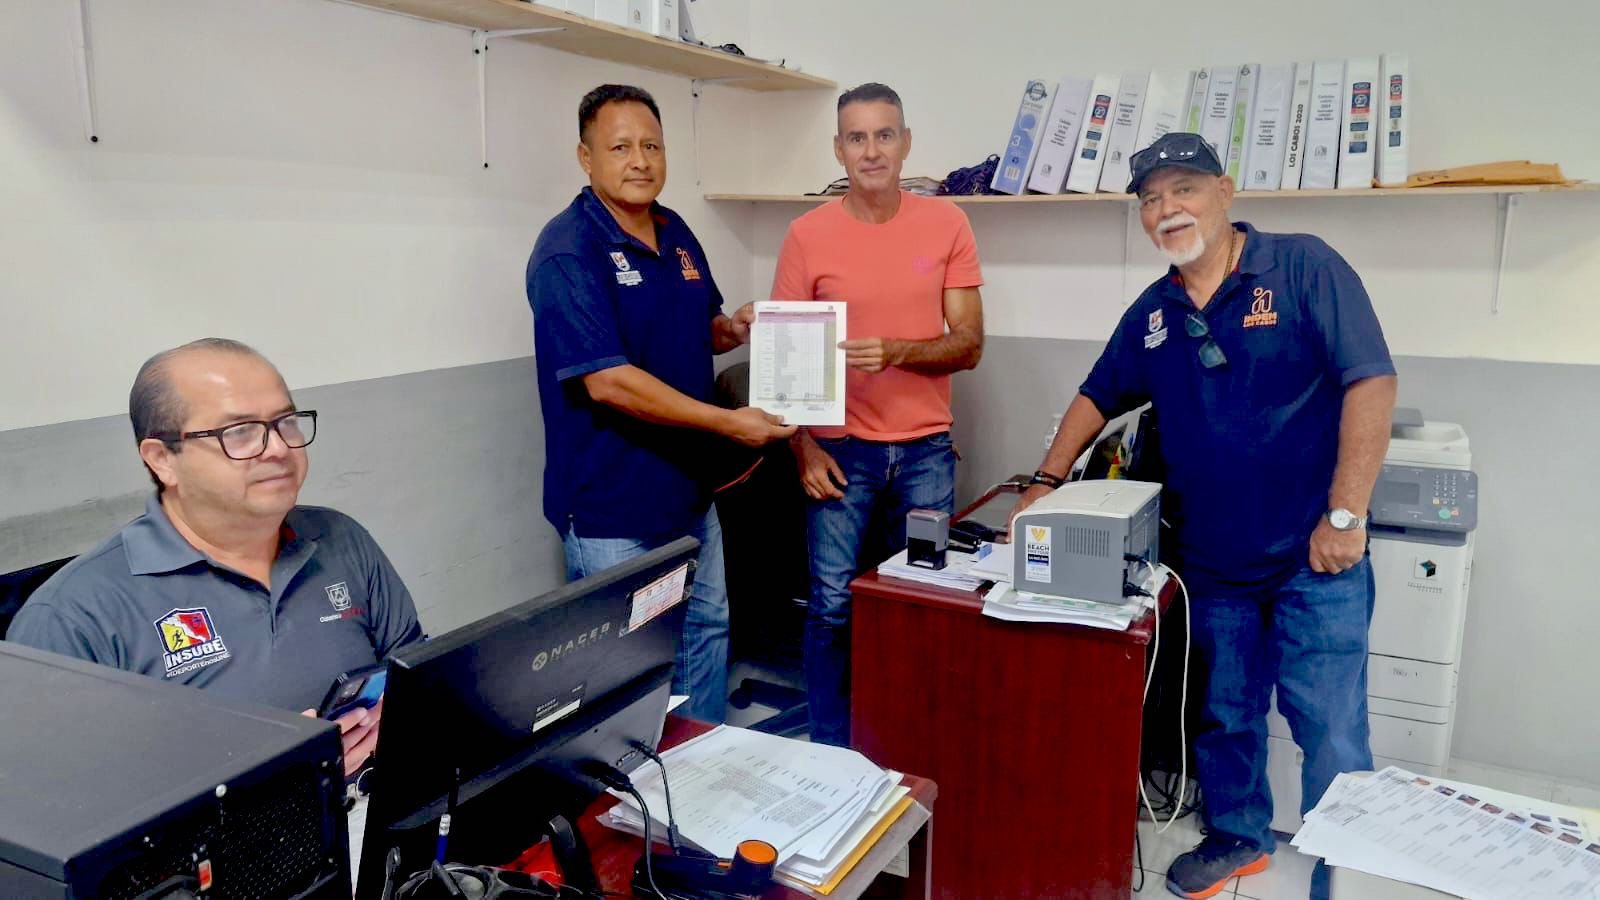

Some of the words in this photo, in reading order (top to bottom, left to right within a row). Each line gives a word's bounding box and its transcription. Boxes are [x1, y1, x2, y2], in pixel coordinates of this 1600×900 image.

[1291, 126, 1300, 152] CABOS
[1289, 153, 1297, 167] LOS
[165, 639, 224, 668] INSUDE
